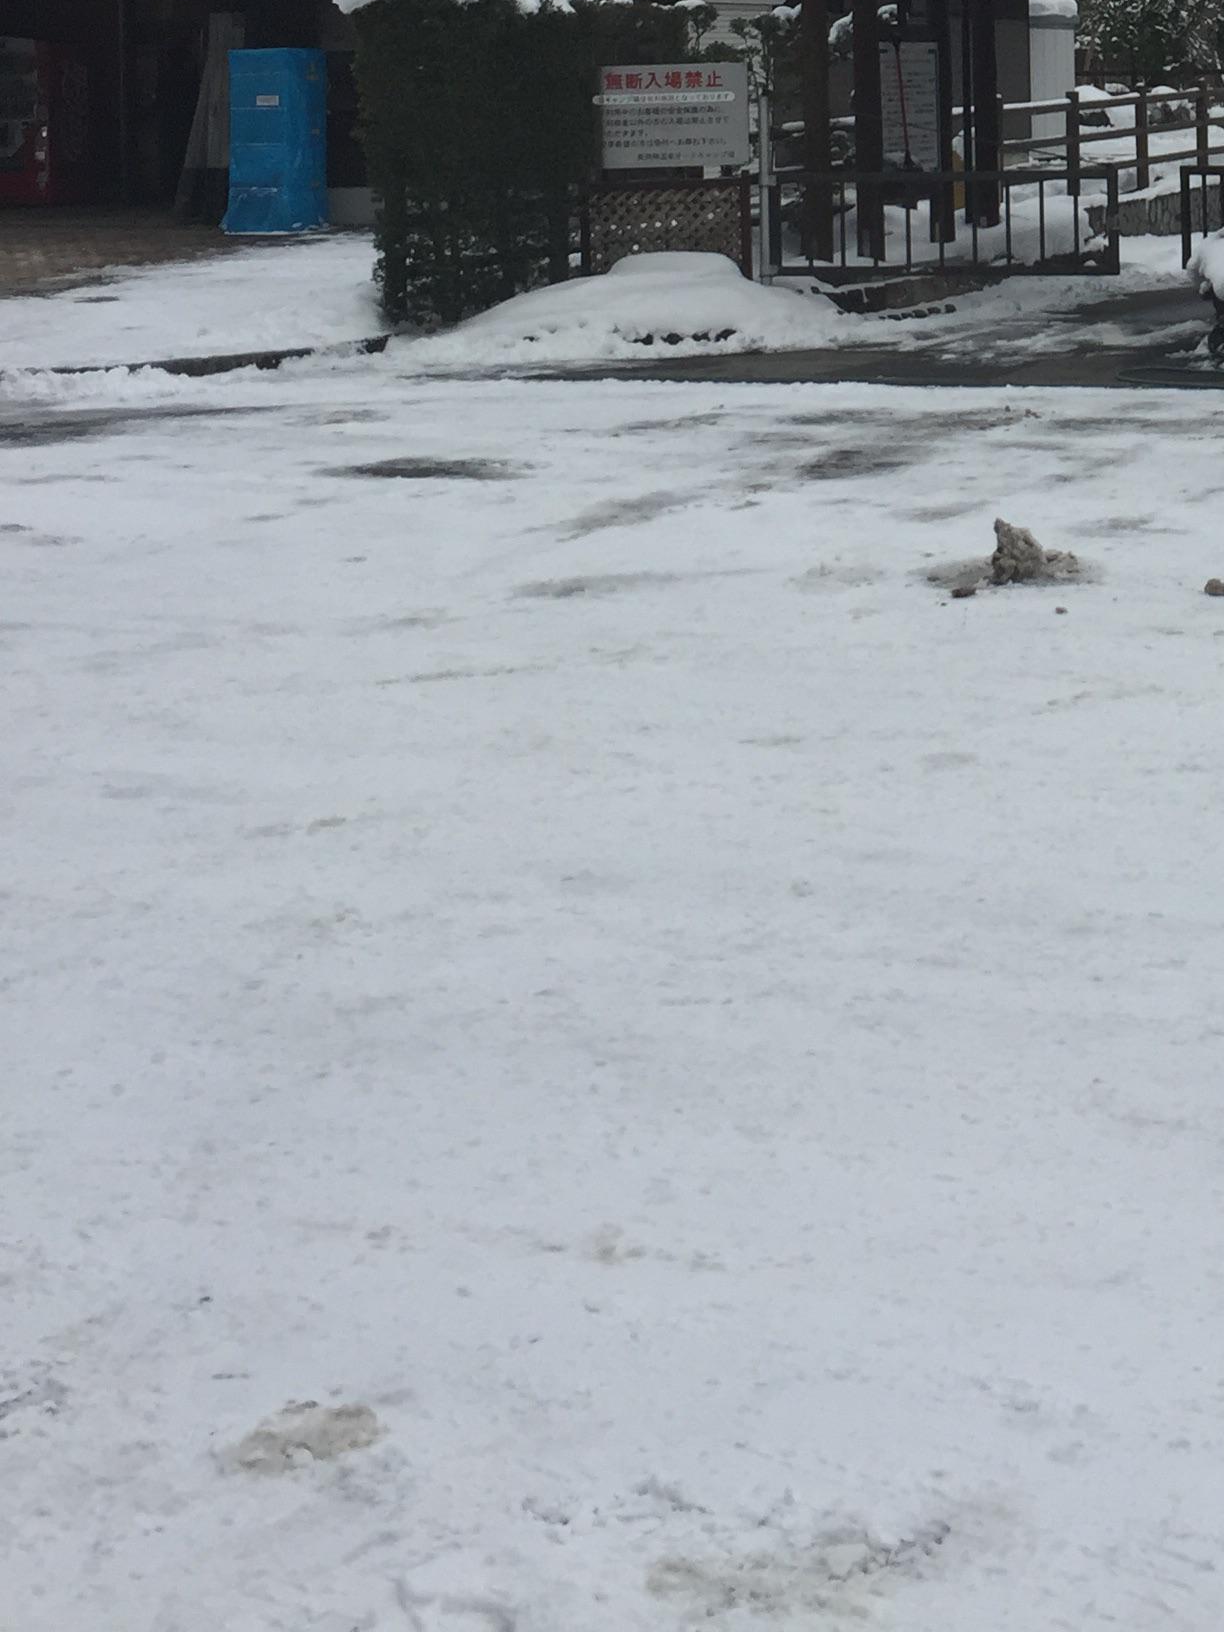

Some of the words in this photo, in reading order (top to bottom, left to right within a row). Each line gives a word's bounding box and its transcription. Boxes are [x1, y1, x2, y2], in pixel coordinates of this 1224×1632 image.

[603, 70, 724, 90] 無断入場禁止
